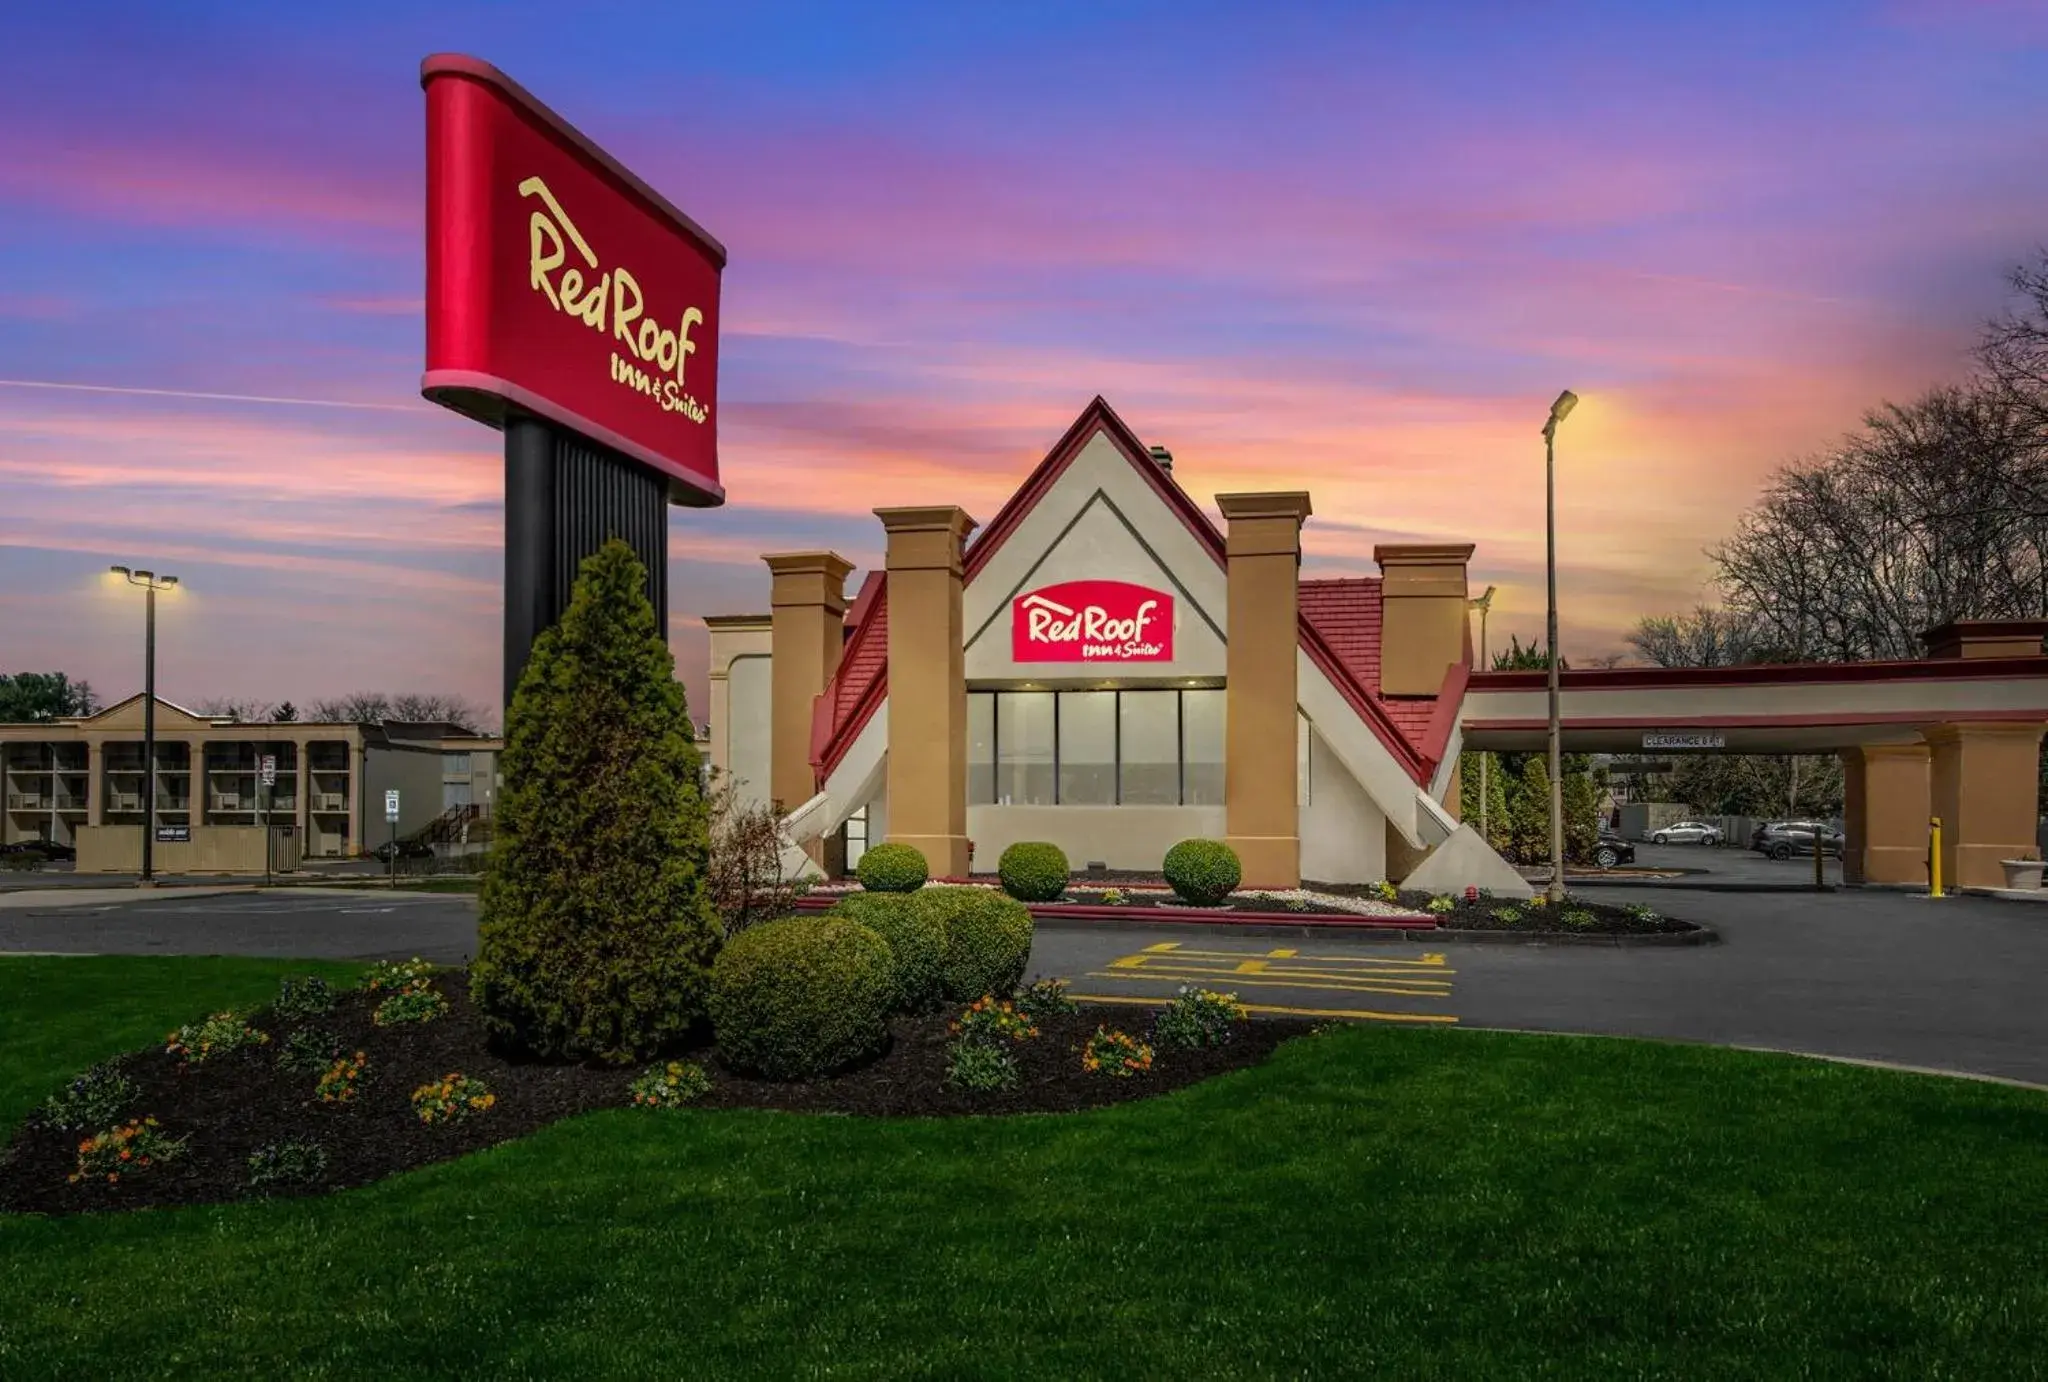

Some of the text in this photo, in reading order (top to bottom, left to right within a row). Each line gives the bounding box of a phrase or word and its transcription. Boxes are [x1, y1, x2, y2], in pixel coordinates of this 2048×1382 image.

[611, 352, 706, 424] Inn & Suites
[1082, 644, 1114, 657] Inn
[1646, 735, 1700, 746] CLEARANCE
